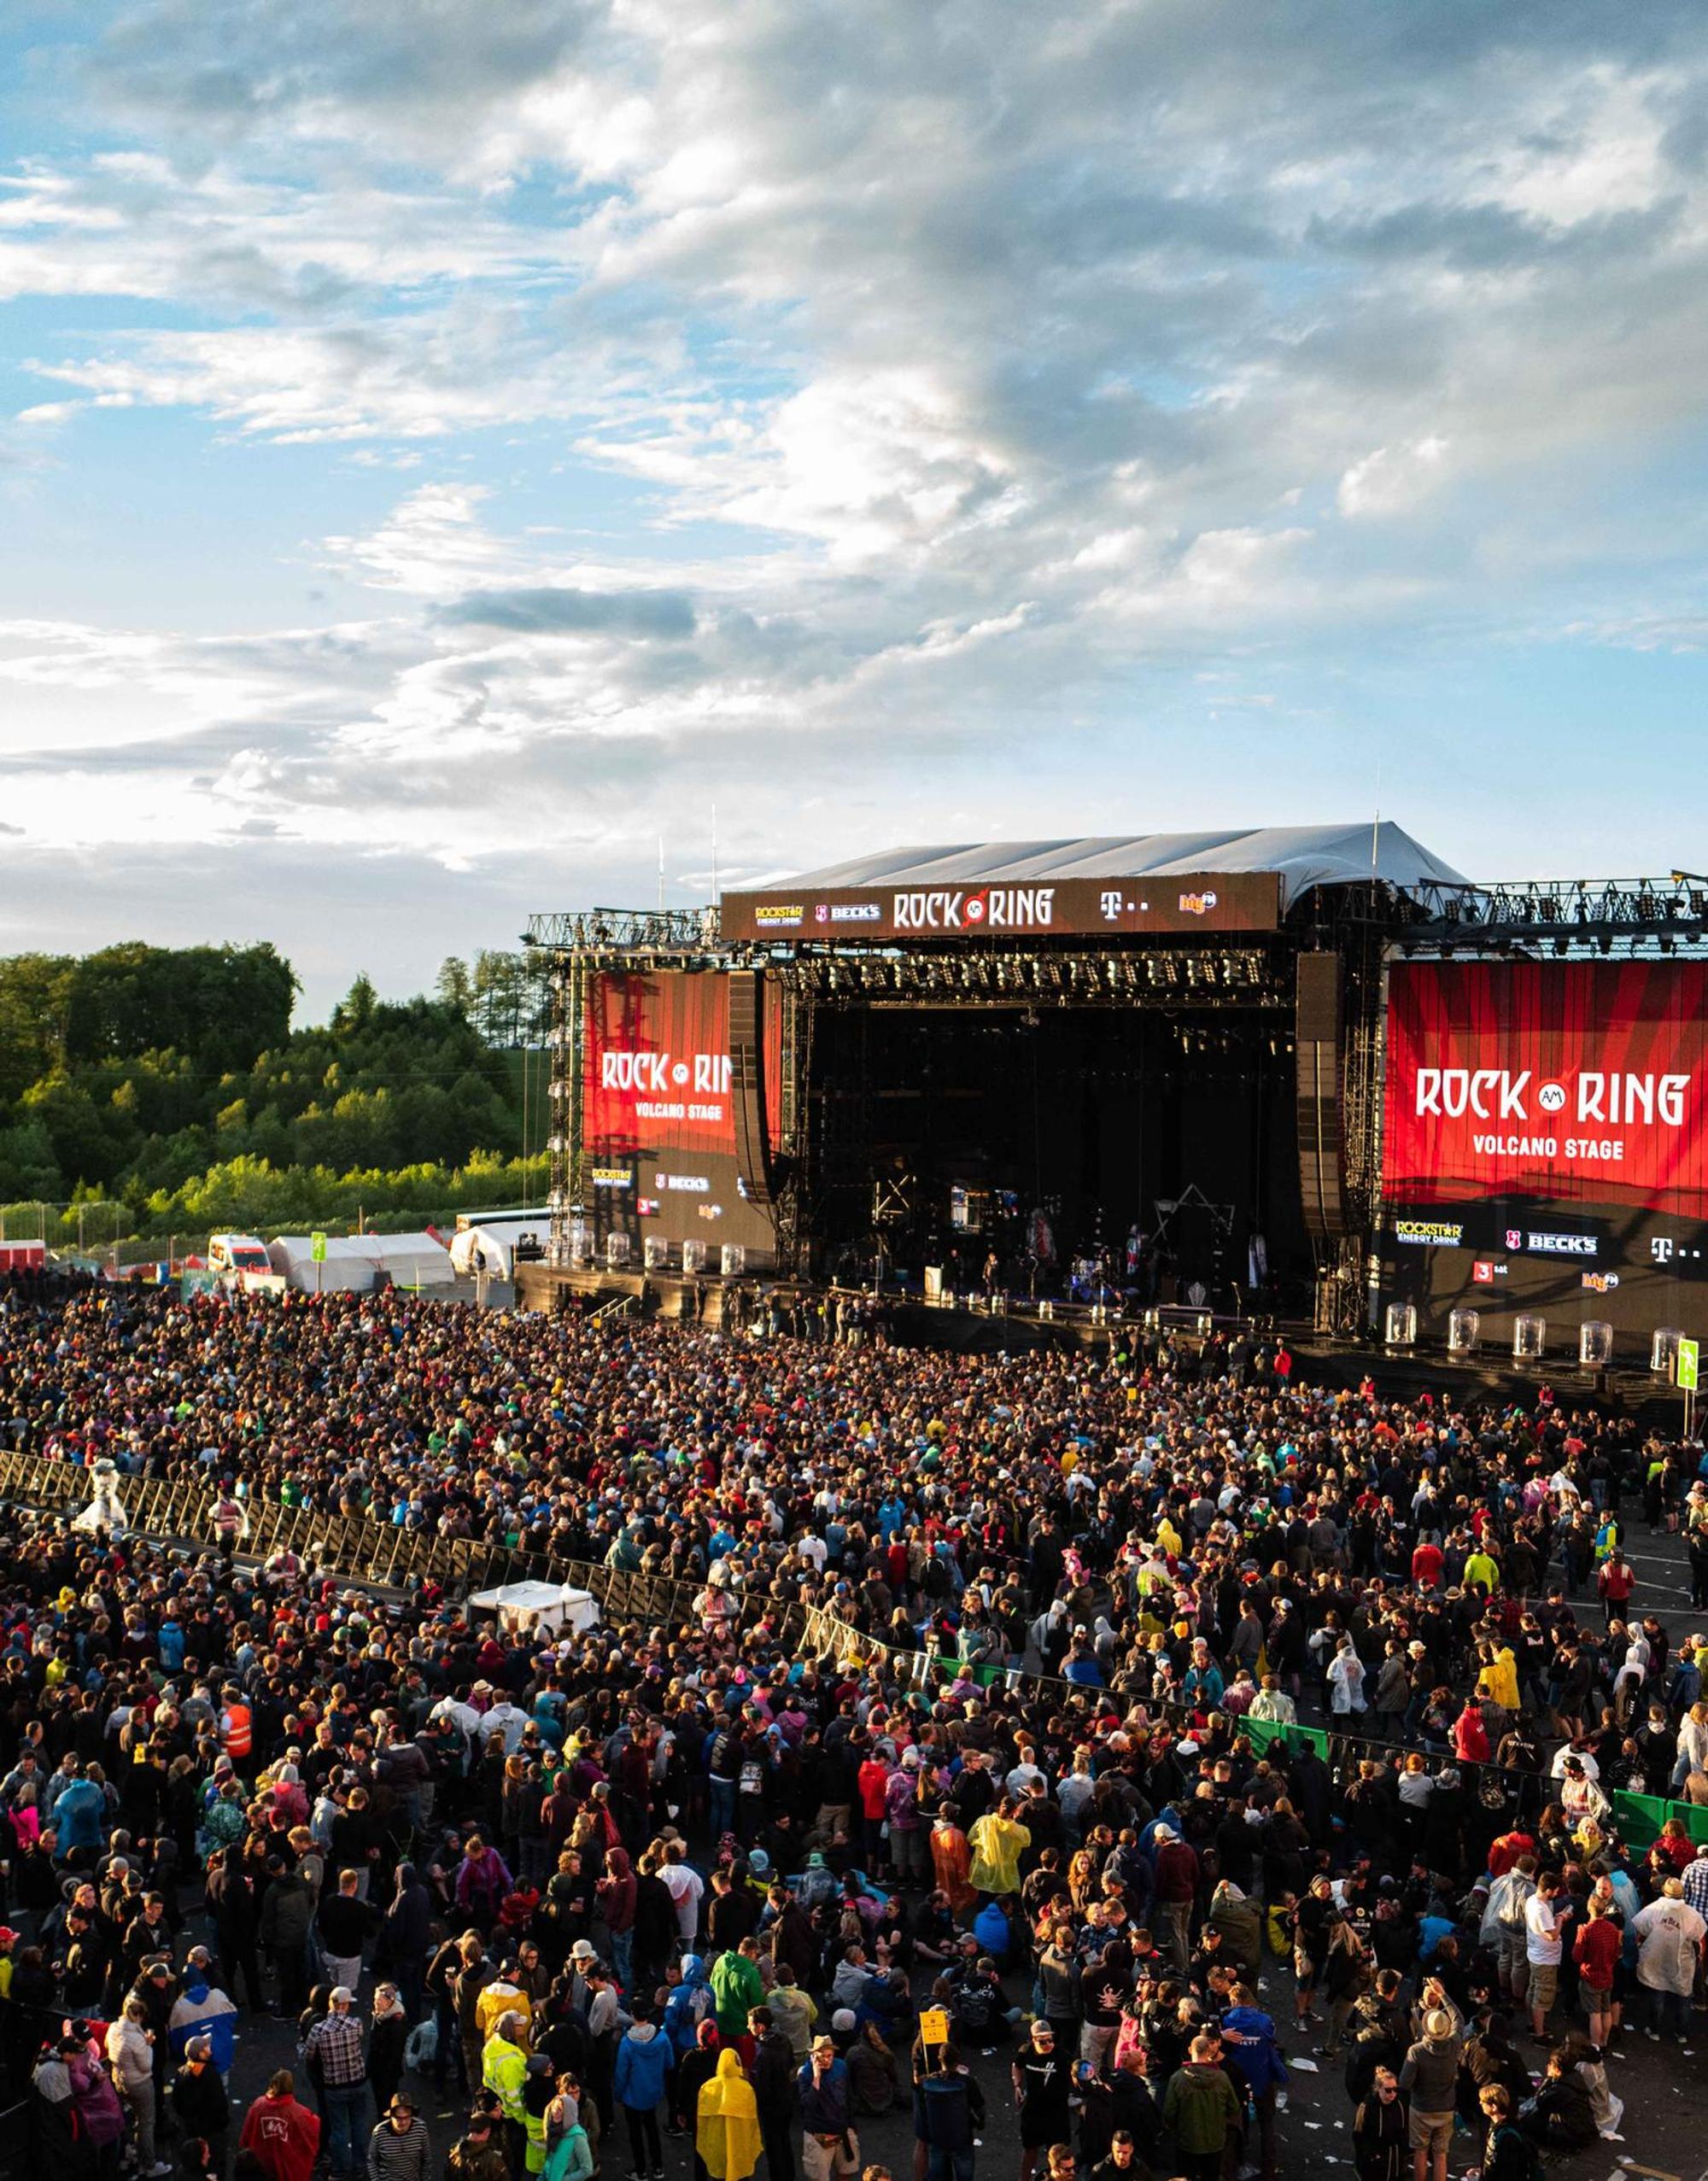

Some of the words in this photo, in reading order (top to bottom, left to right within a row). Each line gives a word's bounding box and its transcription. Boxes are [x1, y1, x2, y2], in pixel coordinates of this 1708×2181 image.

[756, 906, 803, 918] ROCKSTAR
[832, 906, 880, 920] BECK'S
[893, 892, 962, 928] ROCK
[989, 889, 1055, 927] RING
[602, 1052, 669, 1091] ROCK
[694, 1054, 733, 1093] RIN
[1416, 1067, 1531, 1120] ROCK
[1541, 1090, 1562, 1103] AM
[1577, 1072, 1691, 1126] RING
[635, 1102, 685, 1120] VOLCANO
[687, 1103, 722, 1120] STAGE
[1473, 1135, 1557, 1157] VOLCANO
[1565, 1138, 1623, 1160] STAGE
[1395, 1220, 1462, 1238] ROCKSTAR
[1397, 1233, 1430, 1244] ENERGY
[1432, 1236, 1460, 1247] DRINK
[1529, 1234, 1597, 1253] BECK'S
